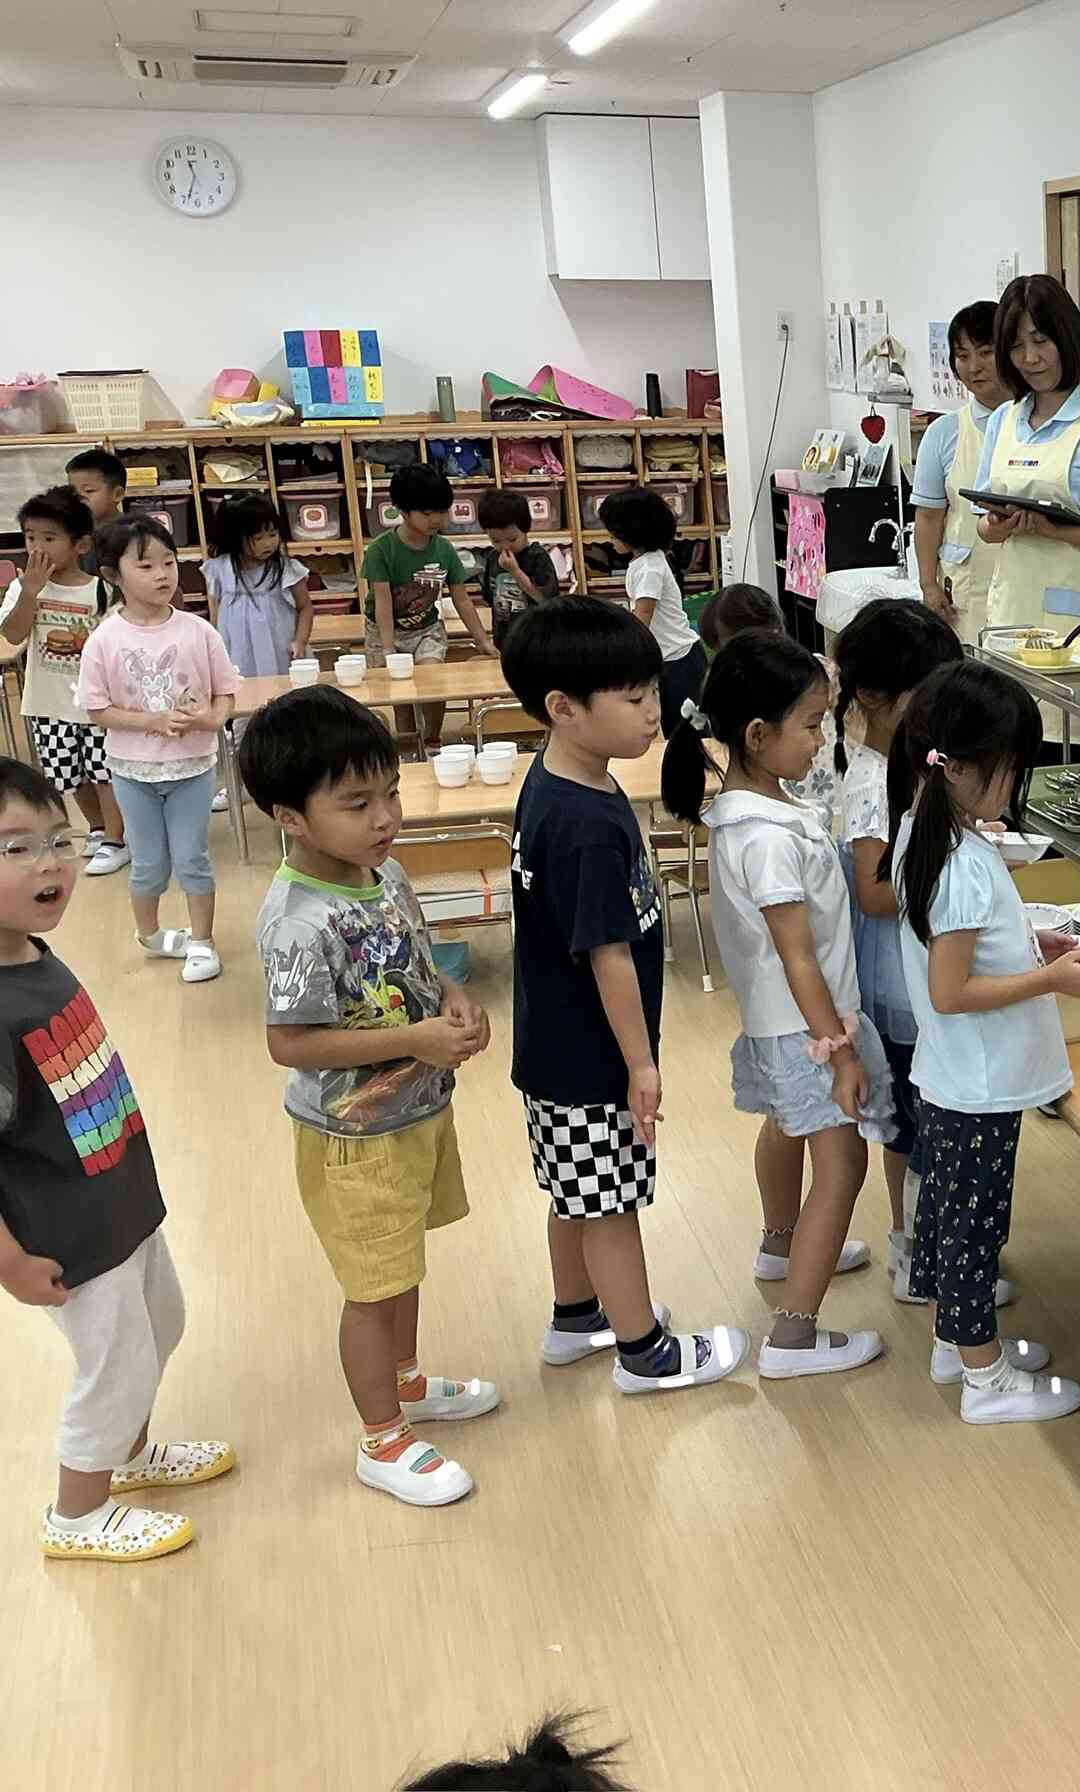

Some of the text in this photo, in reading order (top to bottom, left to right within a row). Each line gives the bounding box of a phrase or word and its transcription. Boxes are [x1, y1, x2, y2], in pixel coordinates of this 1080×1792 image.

[174, 149, 182, 159] 11
[186, 145, 196, 156] 12
[202, 149, 207, 159] 1
[166, 160, 174, 168] 10
[212, 160, 220, 168] 2
[163, 173, 171, 181] 9
[217, 173, 225, 181] 3
[169, 185, 176, 194] 8
[215, 185, 222, 194] 4
[180, 195, 187, 204] 7
[194, 199, 201, 208] 6
[208, 195, 215, 204] 5
